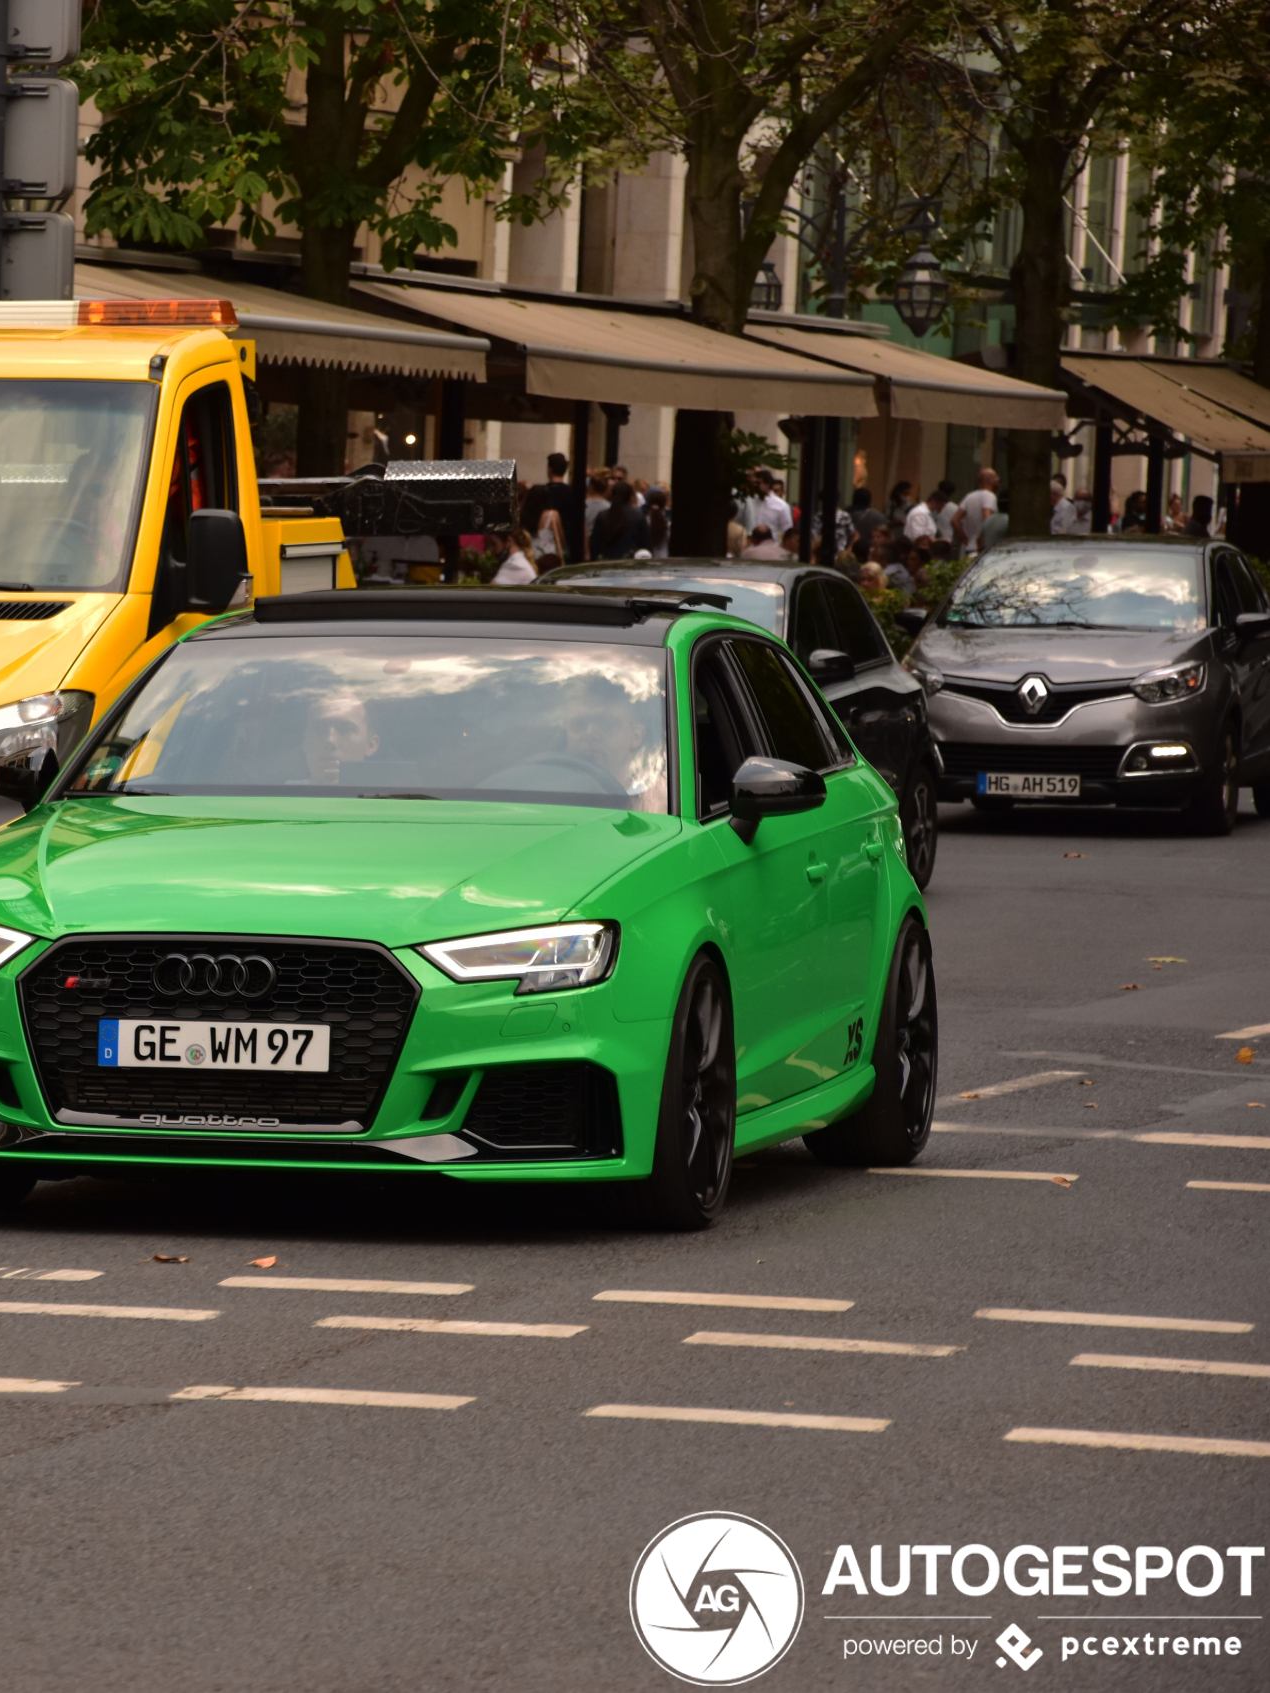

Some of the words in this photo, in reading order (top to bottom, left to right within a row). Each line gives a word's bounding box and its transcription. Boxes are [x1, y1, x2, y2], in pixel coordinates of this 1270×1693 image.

[988, 776, 1010, 792] HG
[1021, 777, 1043, 793] AH
[1045, 777, 1078, 793] 519
[133, 1024, 181, 1062] GE
[104, 1048, 113, 1059] D
[139, 1114, 280, 1127] quattro
